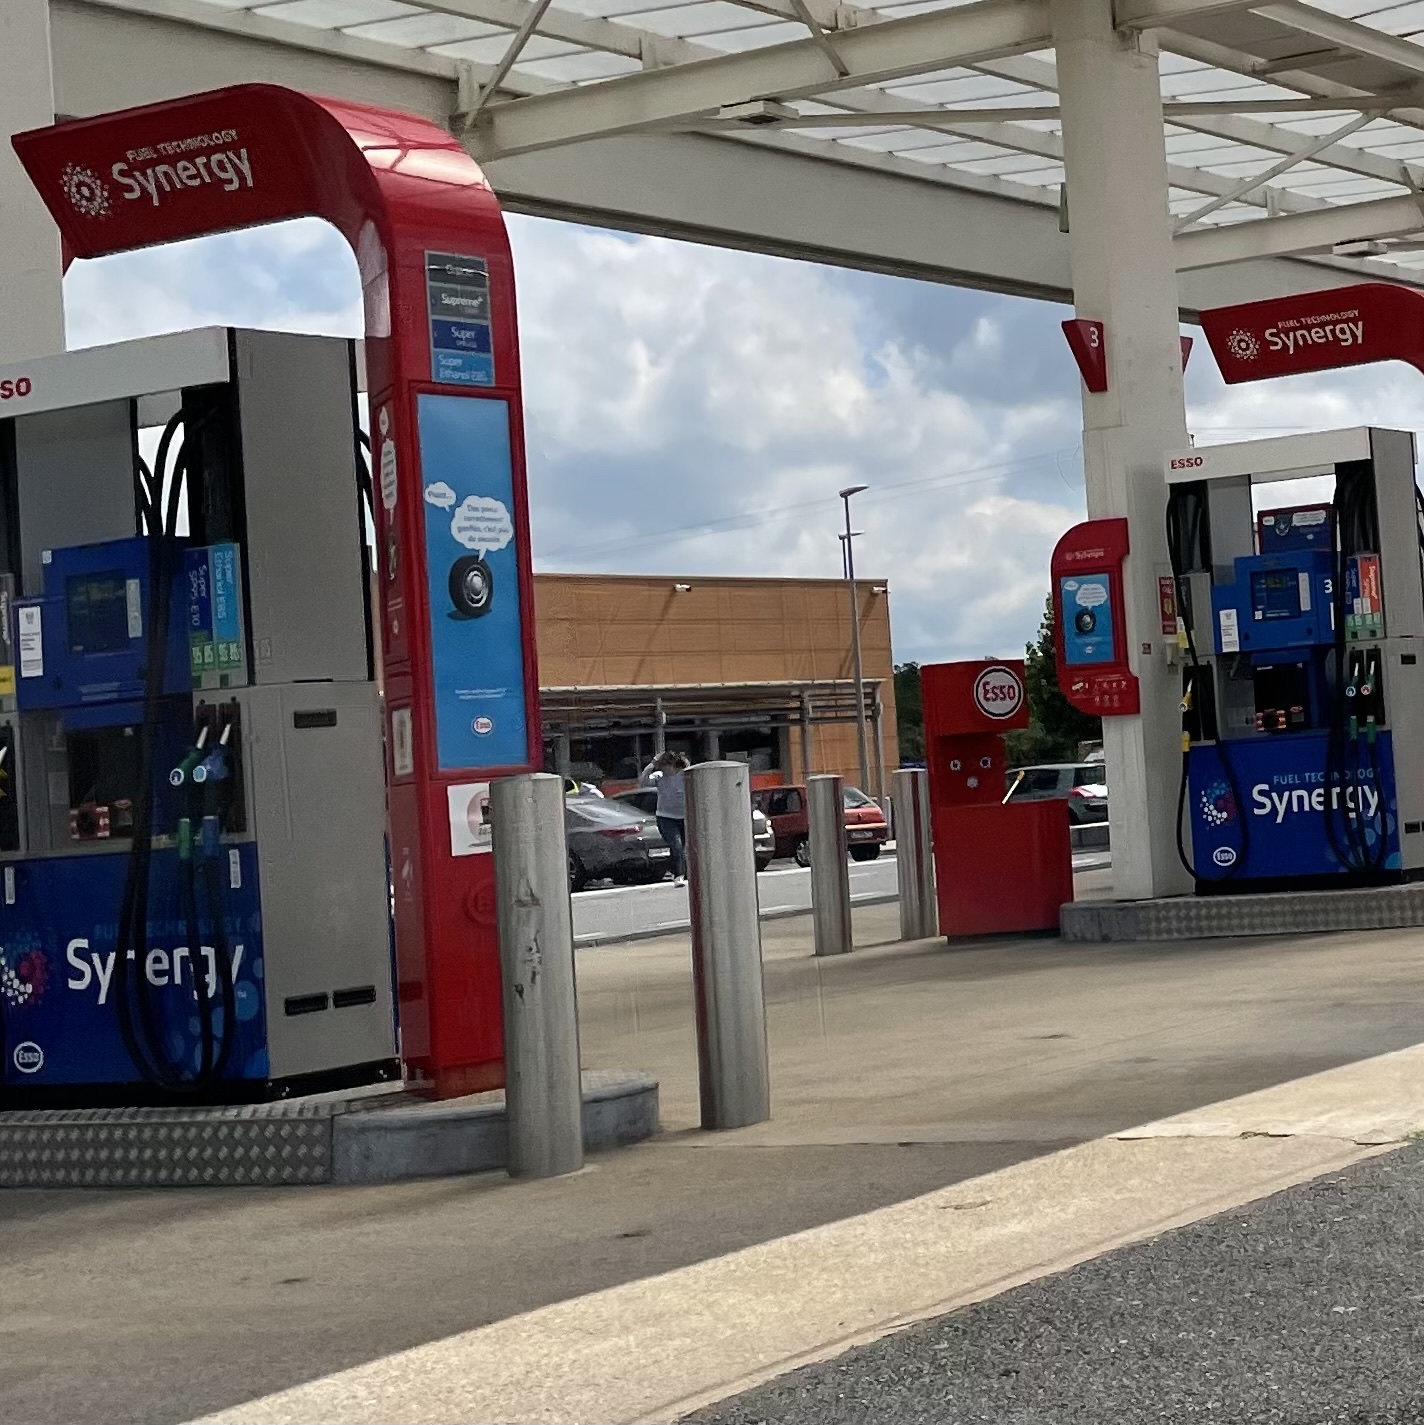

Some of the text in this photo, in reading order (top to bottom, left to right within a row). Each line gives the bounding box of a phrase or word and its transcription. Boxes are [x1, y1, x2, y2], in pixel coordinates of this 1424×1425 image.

[112, 148, 254, 206] Synergy
[1300, 309, 1360, 326] TECHNOLOGY
[1089, 326, 1099, 348] 3
[1264, 320, 1363, 354] Synergy
[1170, 457, 1203, 469] ESSO
[1324, 578, 1333, 594] 3
[982, 680, 1016, 702] Esso
[1273, 774, 1300, 786] FUEL
[1251, 783, 1379, 824] Synergy
